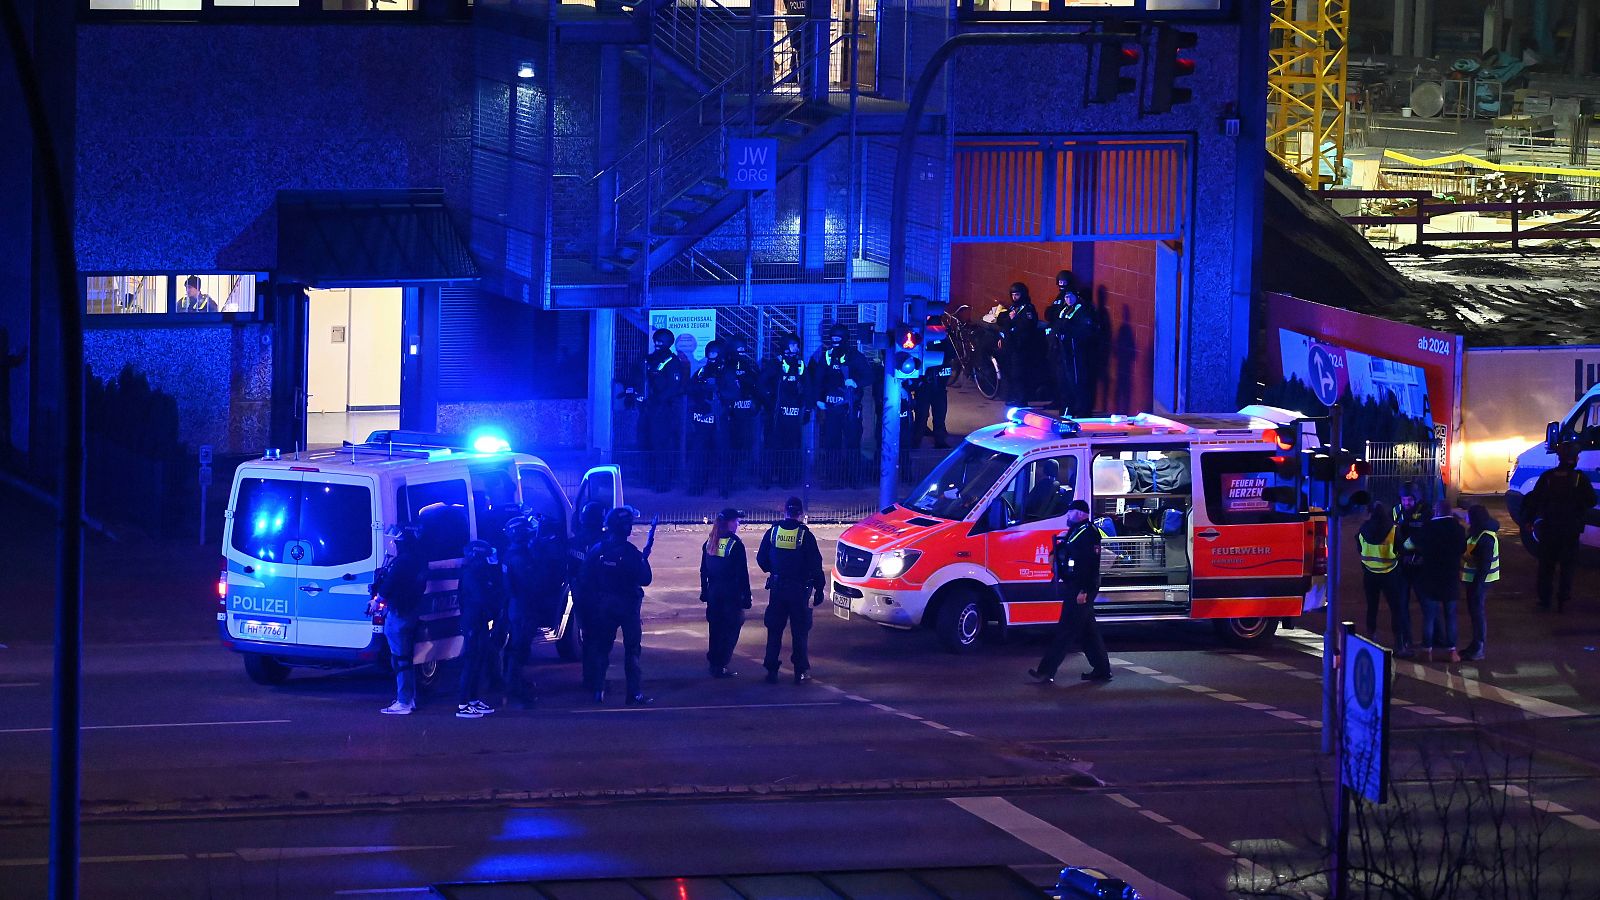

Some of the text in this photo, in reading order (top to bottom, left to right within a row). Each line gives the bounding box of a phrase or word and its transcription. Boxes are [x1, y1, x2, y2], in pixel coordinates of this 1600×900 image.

[738, 146, 768, 166] JW
[1418, 336, 1450, 356] ab 2024
[1328, 352, 1344, 369] 024
[1231, 478, 1265, 488] FEUER IM
[1229, 487, 1264, 498] HERZEN
[777, 534, 797, 543] POLIZEI
[1211, 546, 1272, 555] FEUERWEHR
[232, 595, 289, 614] POLIZEI
[247, 625, 282, 636] HH 7766
